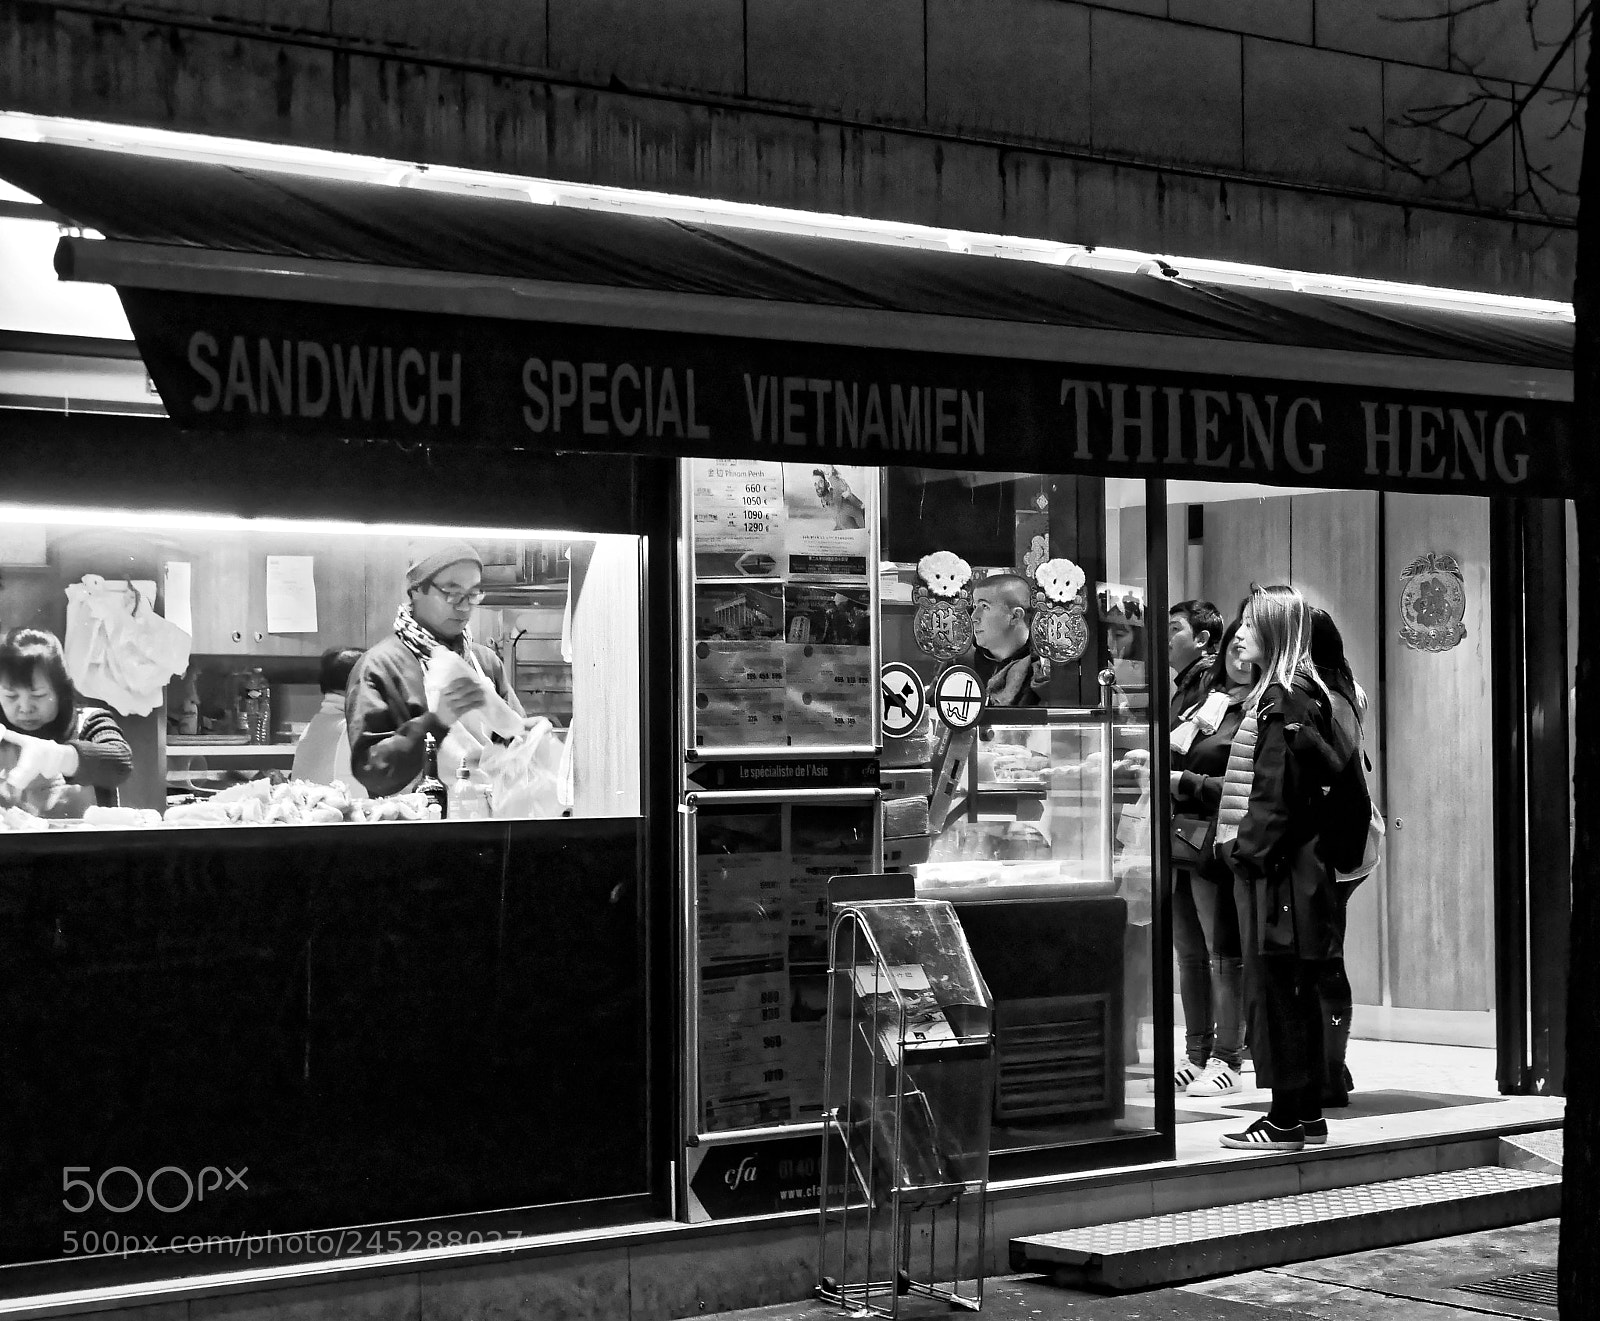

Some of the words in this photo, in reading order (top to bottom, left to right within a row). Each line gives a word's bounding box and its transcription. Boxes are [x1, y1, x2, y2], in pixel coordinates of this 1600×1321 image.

[187, 330, 462, 427] SANDWICH
[522, 357, 710, 440] SPECIAL
[743, 372, 986, 457] VIETNAMIEN
[1060, 378, 1326, 476] THIENG
[1361, 400, 1530, 485] HENG
[745, 484, 761, 493] 660
[742, 496, 762, 506] 1050
[743, 510, 763, 520] 1090
[744, 522, 764, 532] 1290
[739, 765, 750, 778] Le
[750, 764, 794, 780] spécialiste
[795, 764, 805, 777] de
[806, 763, 829, 777] l'Asie
[724, 1156, 758, 1191] cfa
